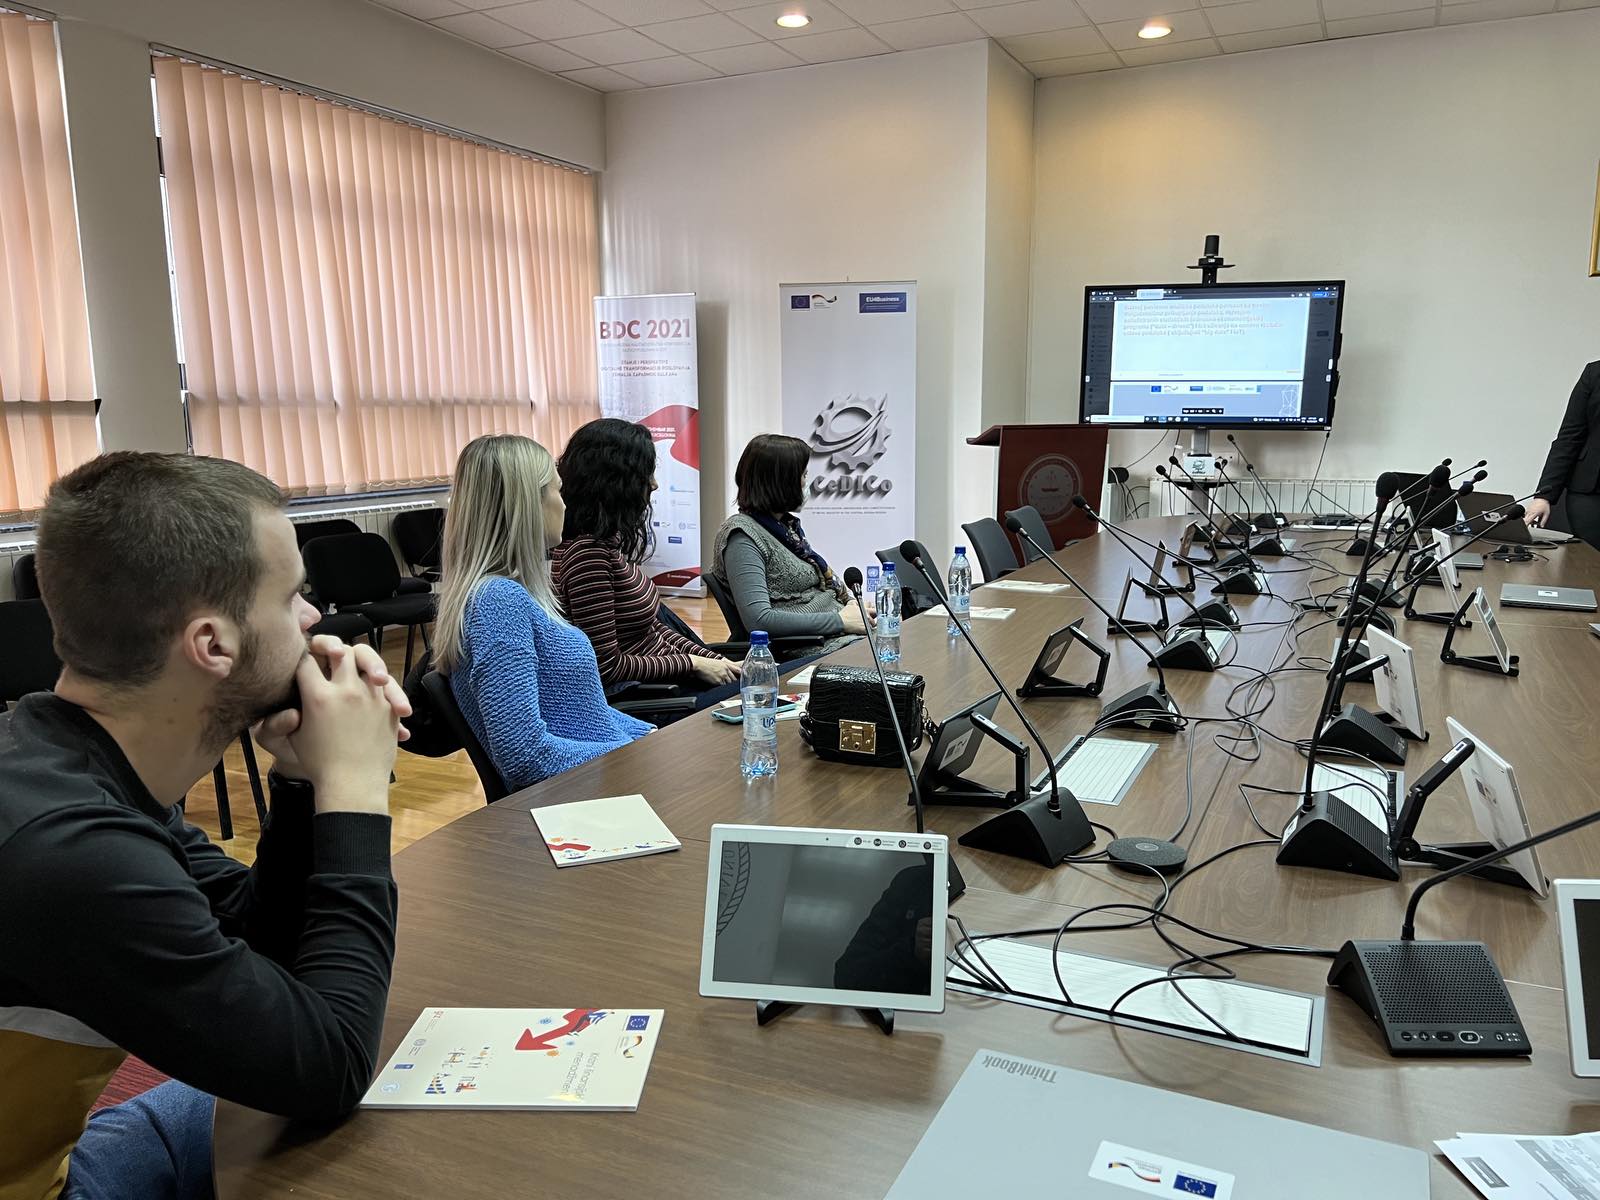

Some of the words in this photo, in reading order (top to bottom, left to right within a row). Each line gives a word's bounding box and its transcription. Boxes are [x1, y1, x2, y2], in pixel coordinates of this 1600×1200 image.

[600, 319, 641, 340] BDC
[646, 318, 691, 339] 2021
[811, 475, 893, 494] CeDICo
[982, 1055, 1058, 1084] ThinkBook
